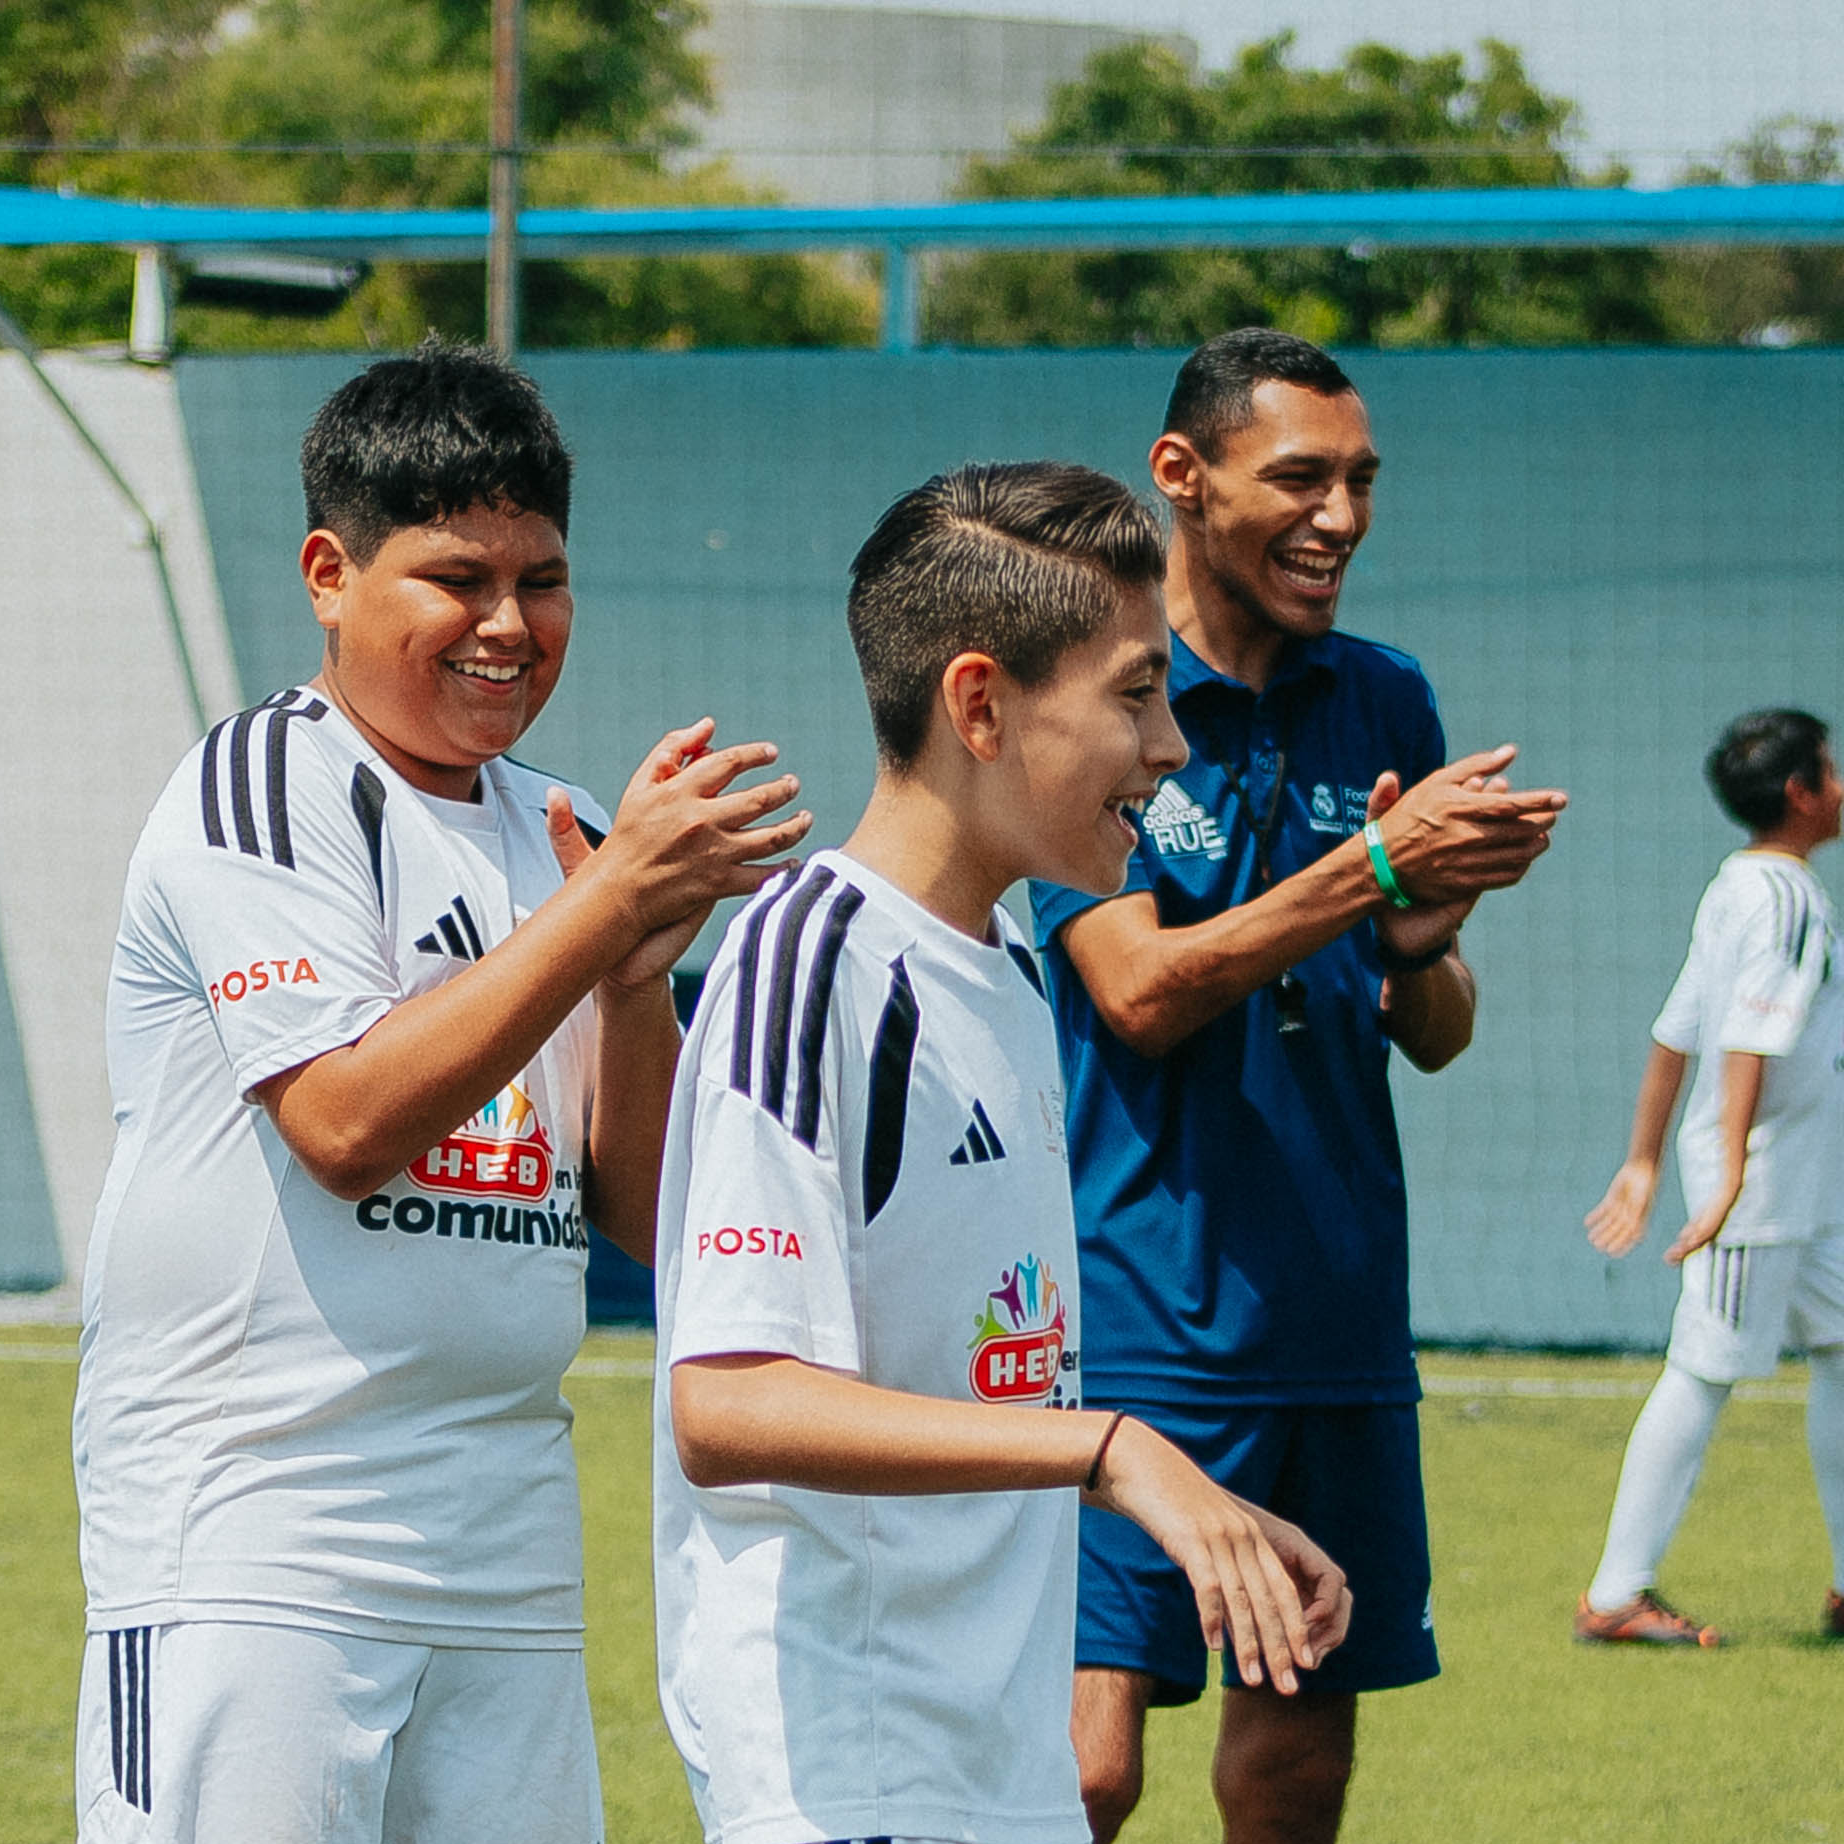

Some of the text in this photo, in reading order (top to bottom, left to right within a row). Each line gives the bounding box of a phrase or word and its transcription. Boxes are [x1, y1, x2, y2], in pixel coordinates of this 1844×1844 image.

[1143, 804, 1204, 829] adidas
[1145, 817, 1228, 855] RUE
[210, 958, 320, 1015] POSTA
[698, 1227, 803, 1261] POSTA
